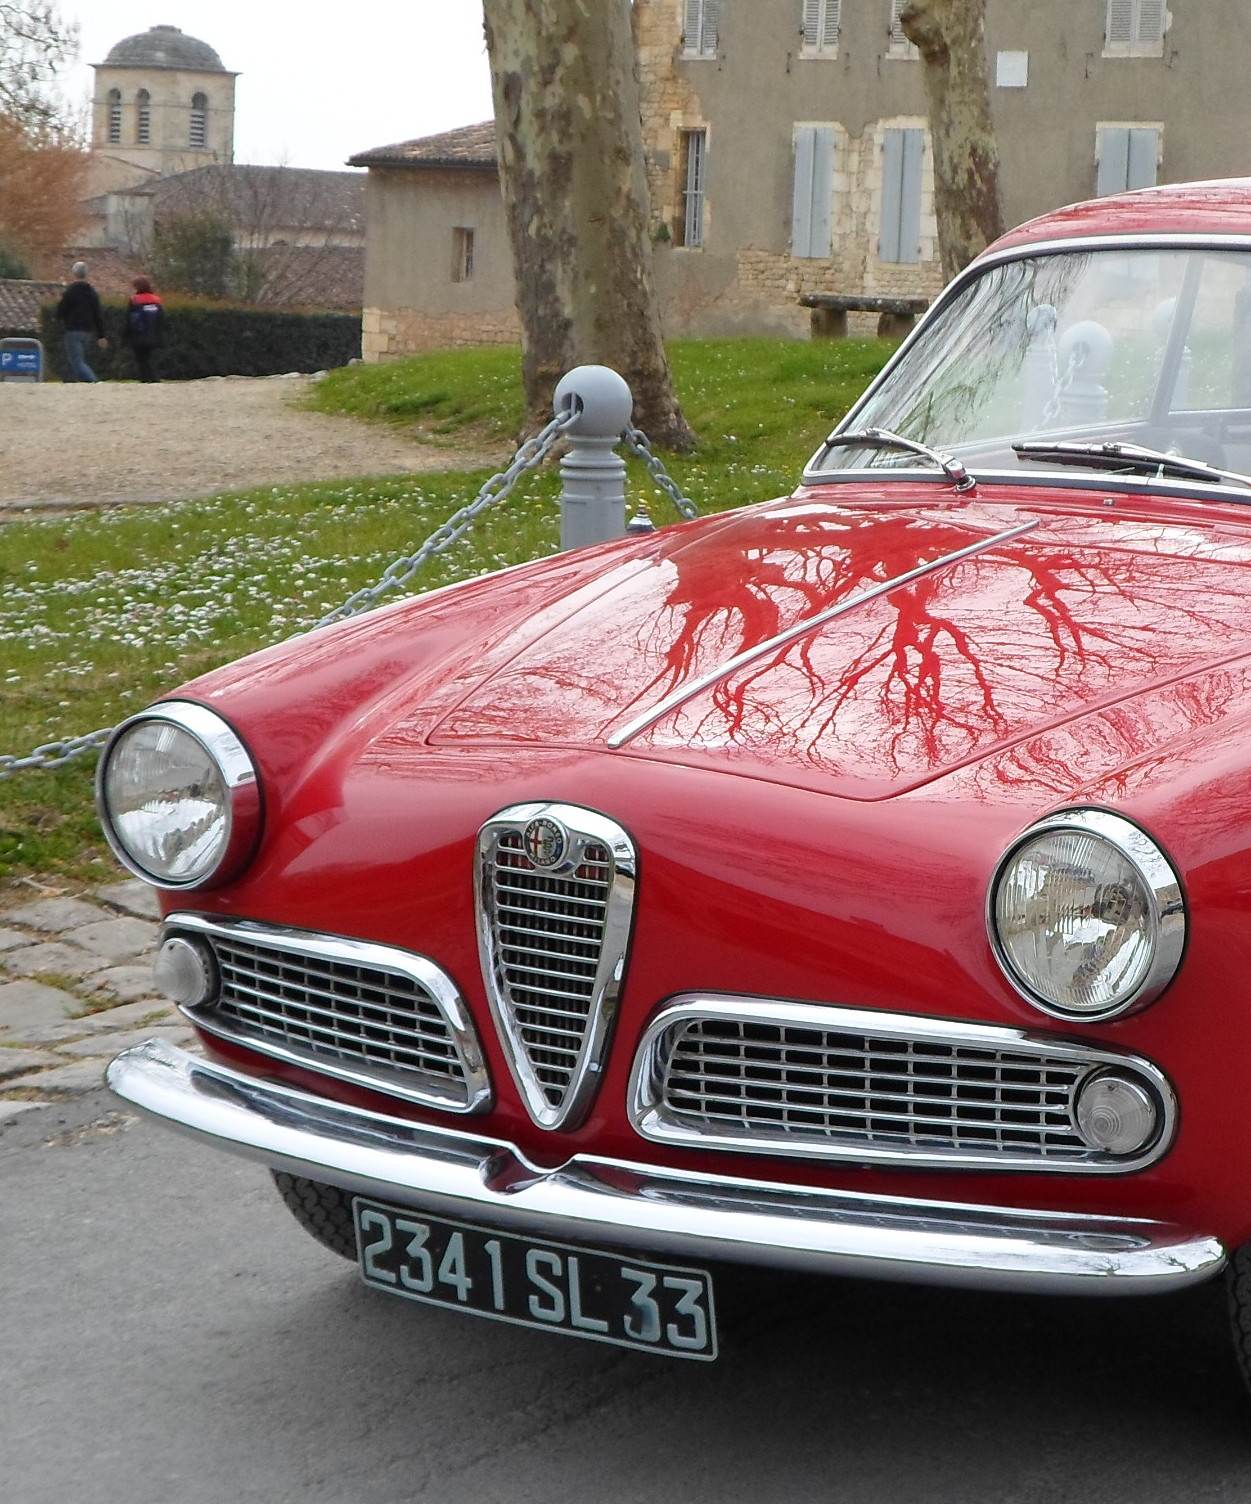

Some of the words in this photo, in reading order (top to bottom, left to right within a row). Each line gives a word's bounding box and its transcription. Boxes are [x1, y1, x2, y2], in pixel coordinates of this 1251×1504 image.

[2, 353, 12, 366] P
[361, 1210, 504, 1310] 2341
[526, 1248, 608, 1332] SL
[620, 1267, 707, 1349] 33
